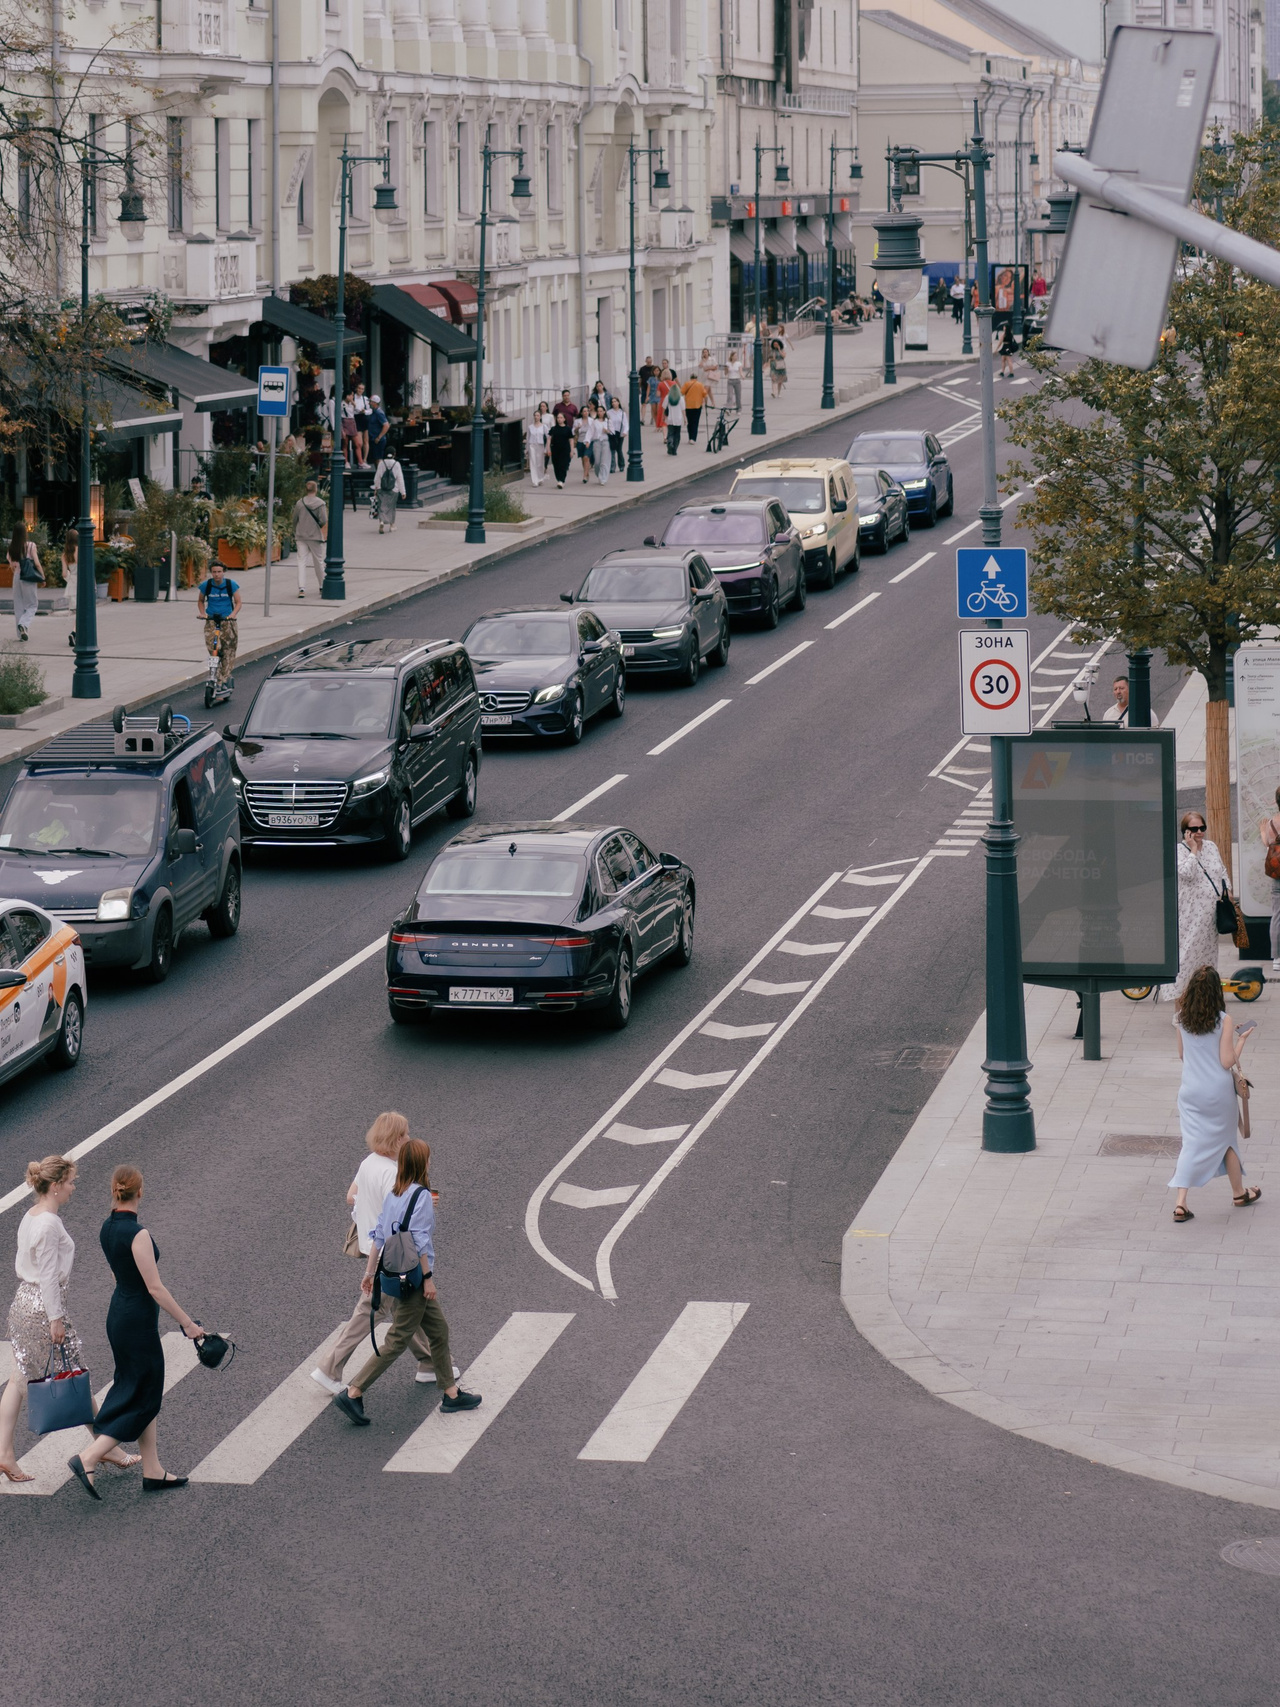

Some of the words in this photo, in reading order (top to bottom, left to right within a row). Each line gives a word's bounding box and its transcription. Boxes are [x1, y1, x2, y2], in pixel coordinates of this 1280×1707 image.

[975, 636, 1013, 648] ЗОНА
[982, 674, 1009, 694] 30
[1125, 752, 1155, 765] ПСБ
[1021, 849, 1097, 864] СВОБОДА
[1021, 867, 1101, 880] РАСЧЕТОВ
